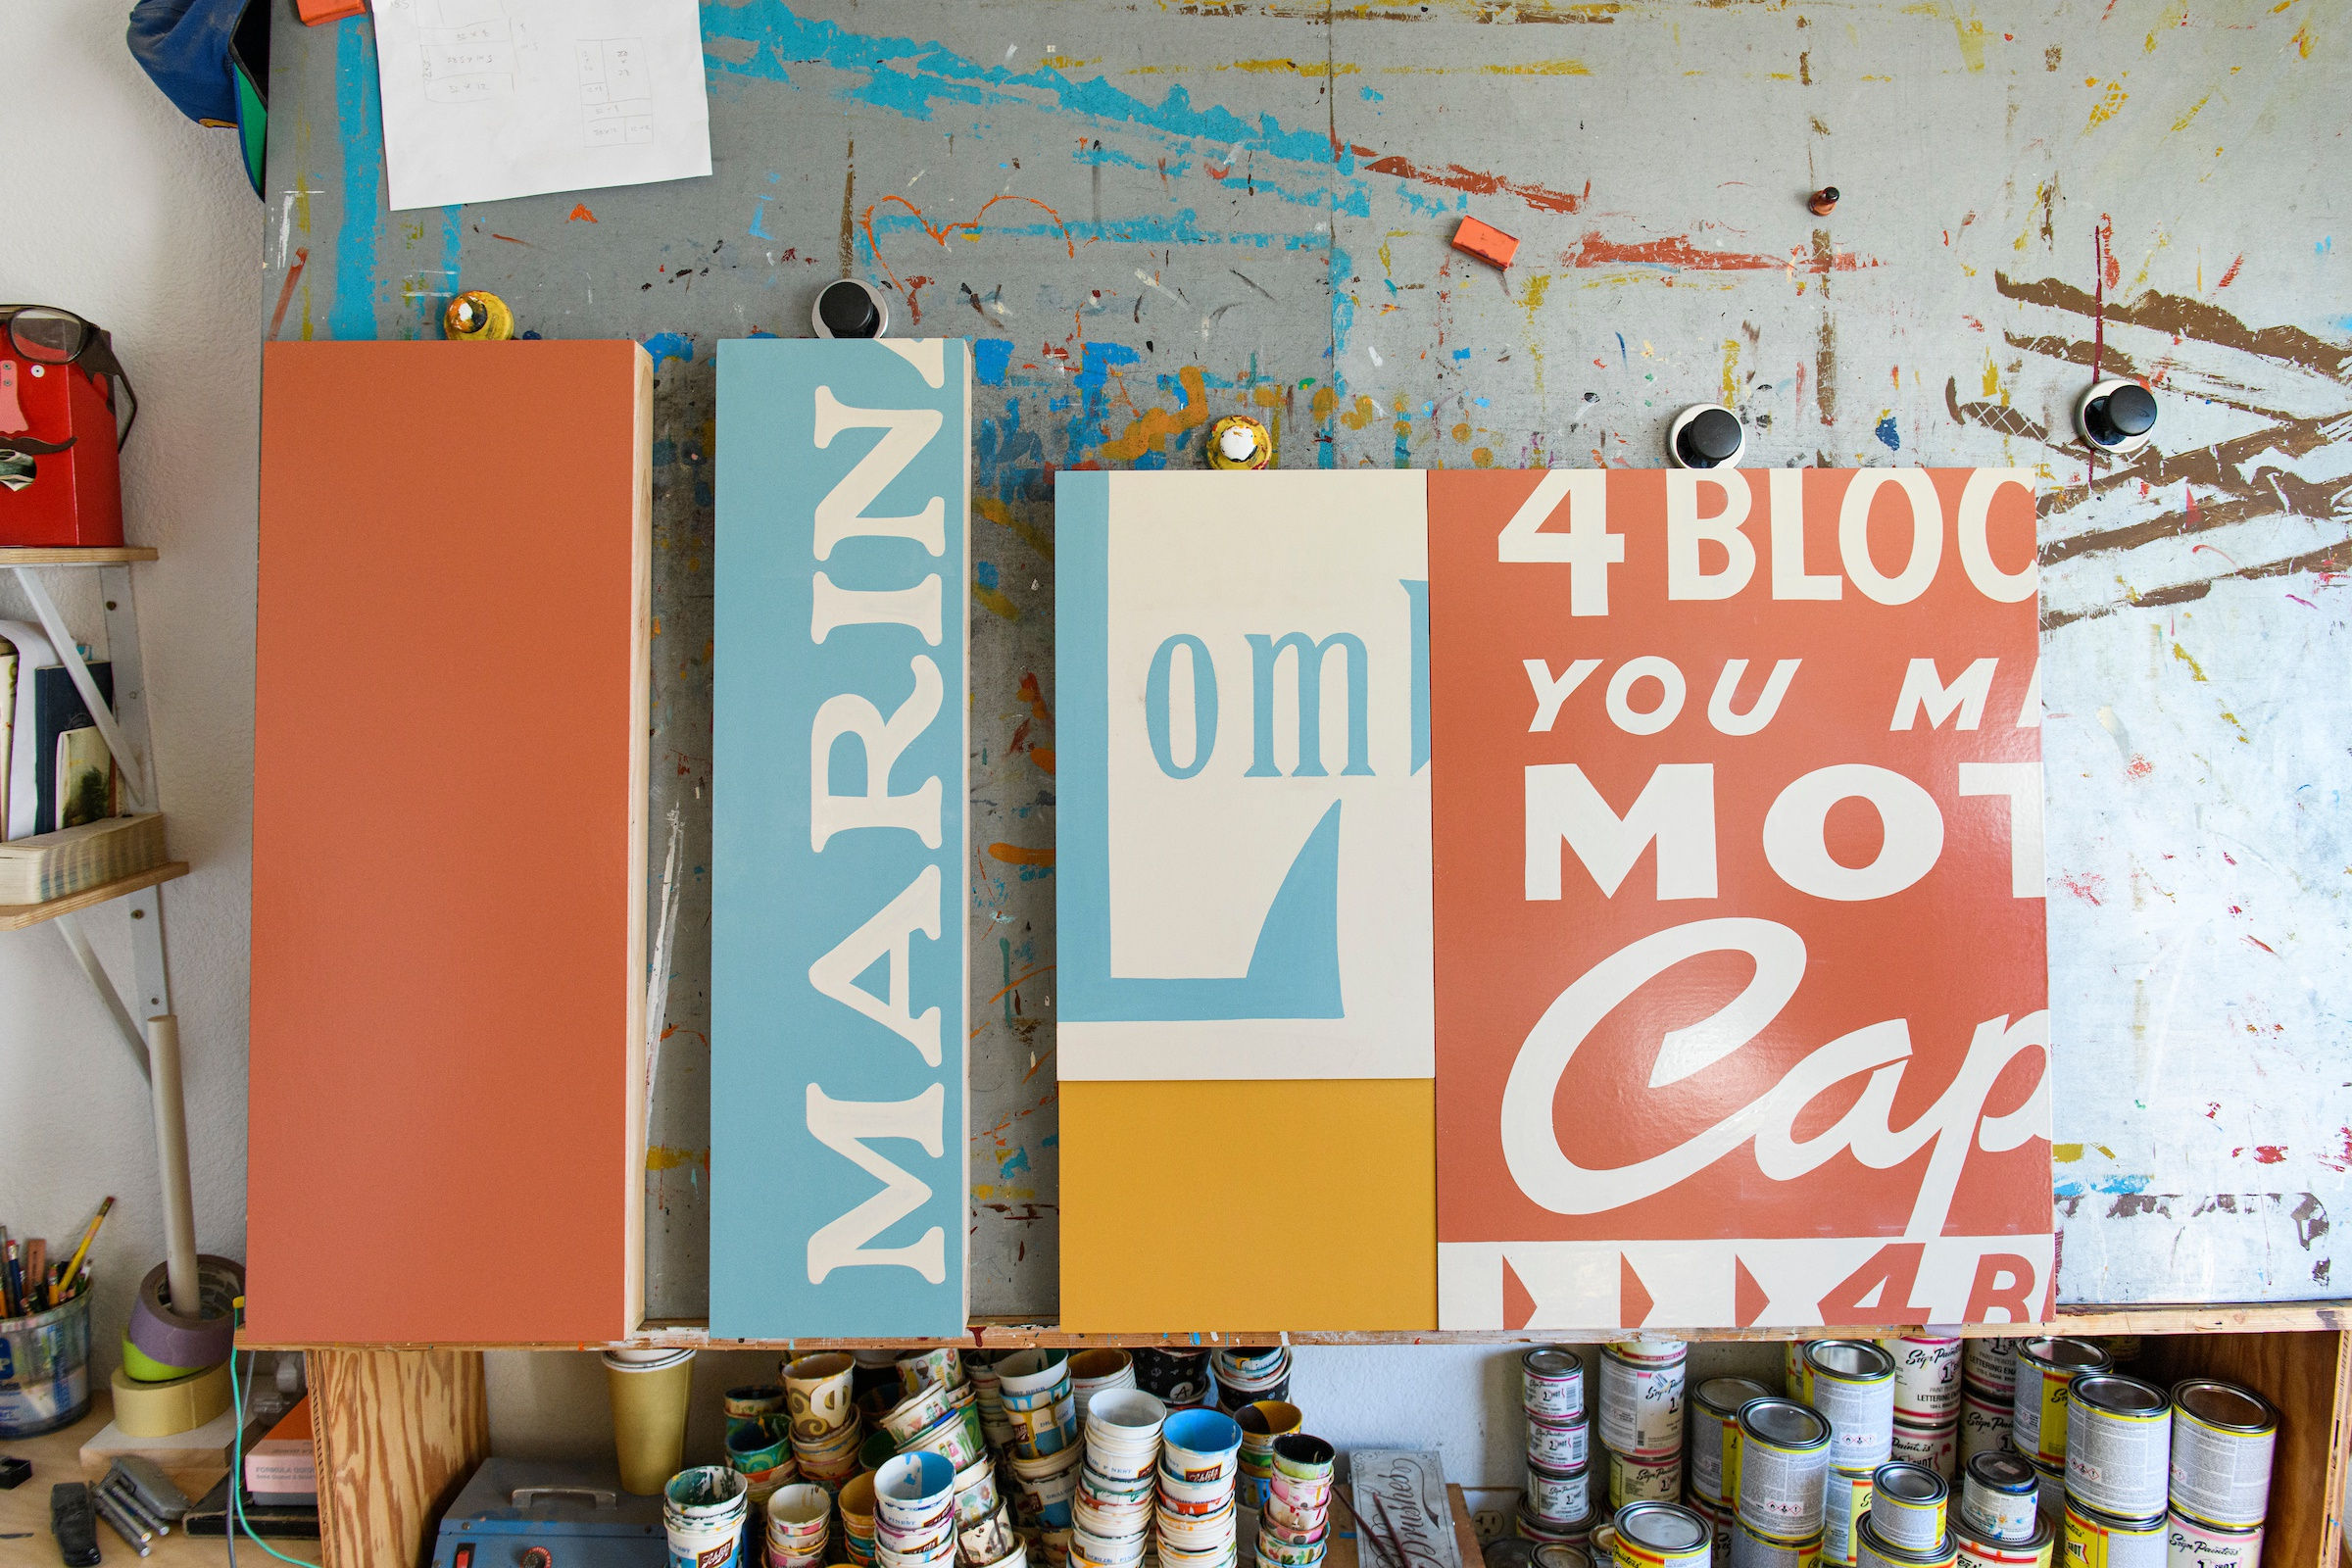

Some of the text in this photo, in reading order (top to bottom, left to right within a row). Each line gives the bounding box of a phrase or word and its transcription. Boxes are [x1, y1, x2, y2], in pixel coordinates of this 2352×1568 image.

[1497, 467, 2039, 616] 4 BLOC
[1522, 655, 1802, 736] YOU
[1525, 762, 2047, 901] MOT
[1499, 916, 2052, 1238] Cap
[1817, 1243, 1933, 1325] 4
[1905, 1348, 1935, 1369] Sign
[2169, 1533, 2193, 1552] Sign
